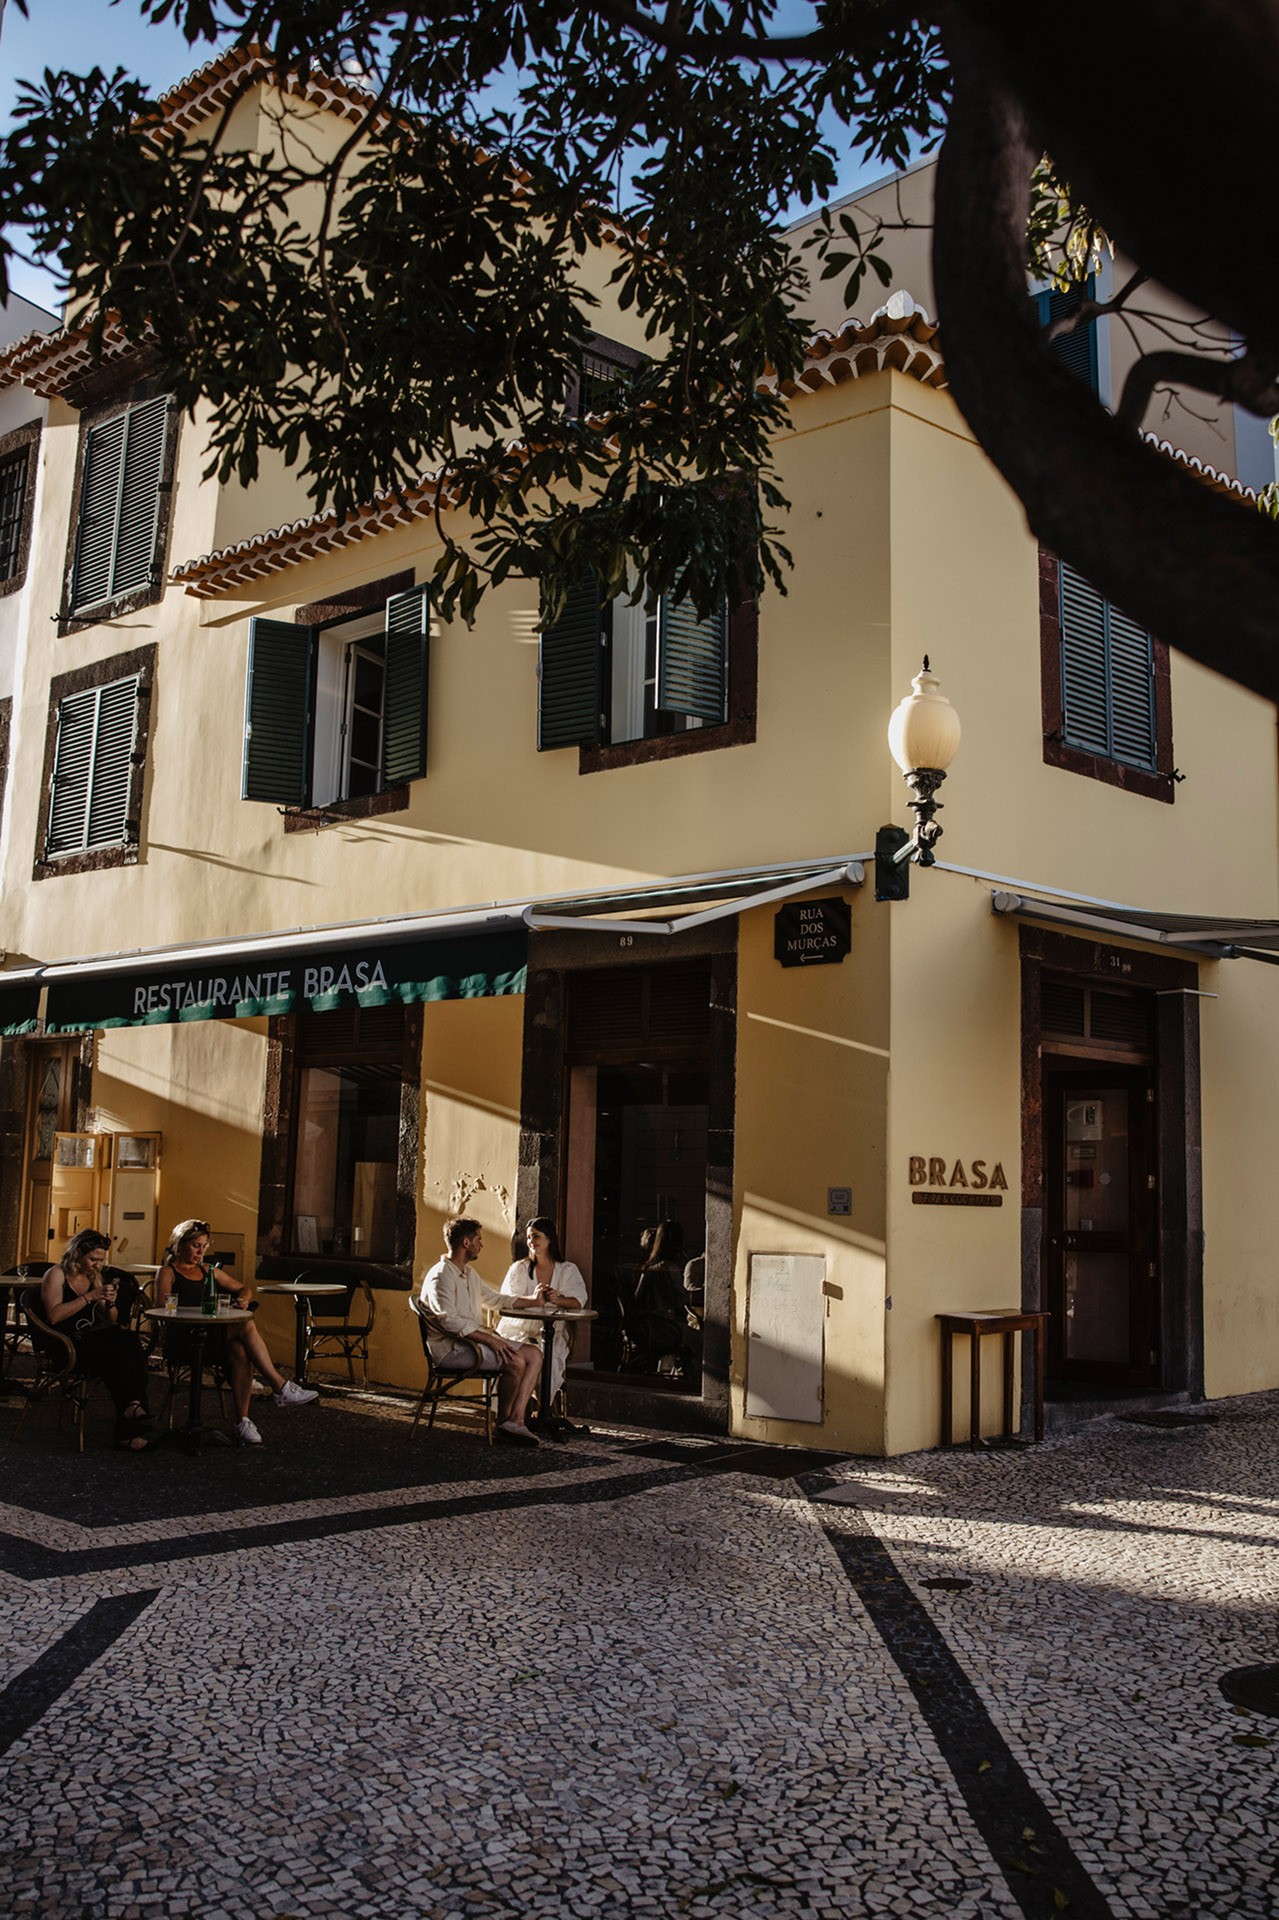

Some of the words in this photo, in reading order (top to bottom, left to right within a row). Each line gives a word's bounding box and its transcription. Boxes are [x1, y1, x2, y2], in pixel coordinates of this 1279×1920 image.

[800, 908, 824, 920] RUA
[800, 922, 824, 935] DOS
[620, 935, 633, 947] 89
[787, 935, 837, 951] MURÇAS
[133, 970, 291, 1014] RESTAURANTE
[303, 960, 388, 998] BRASA
[909, 1156, 1008, 1190] BRASA
